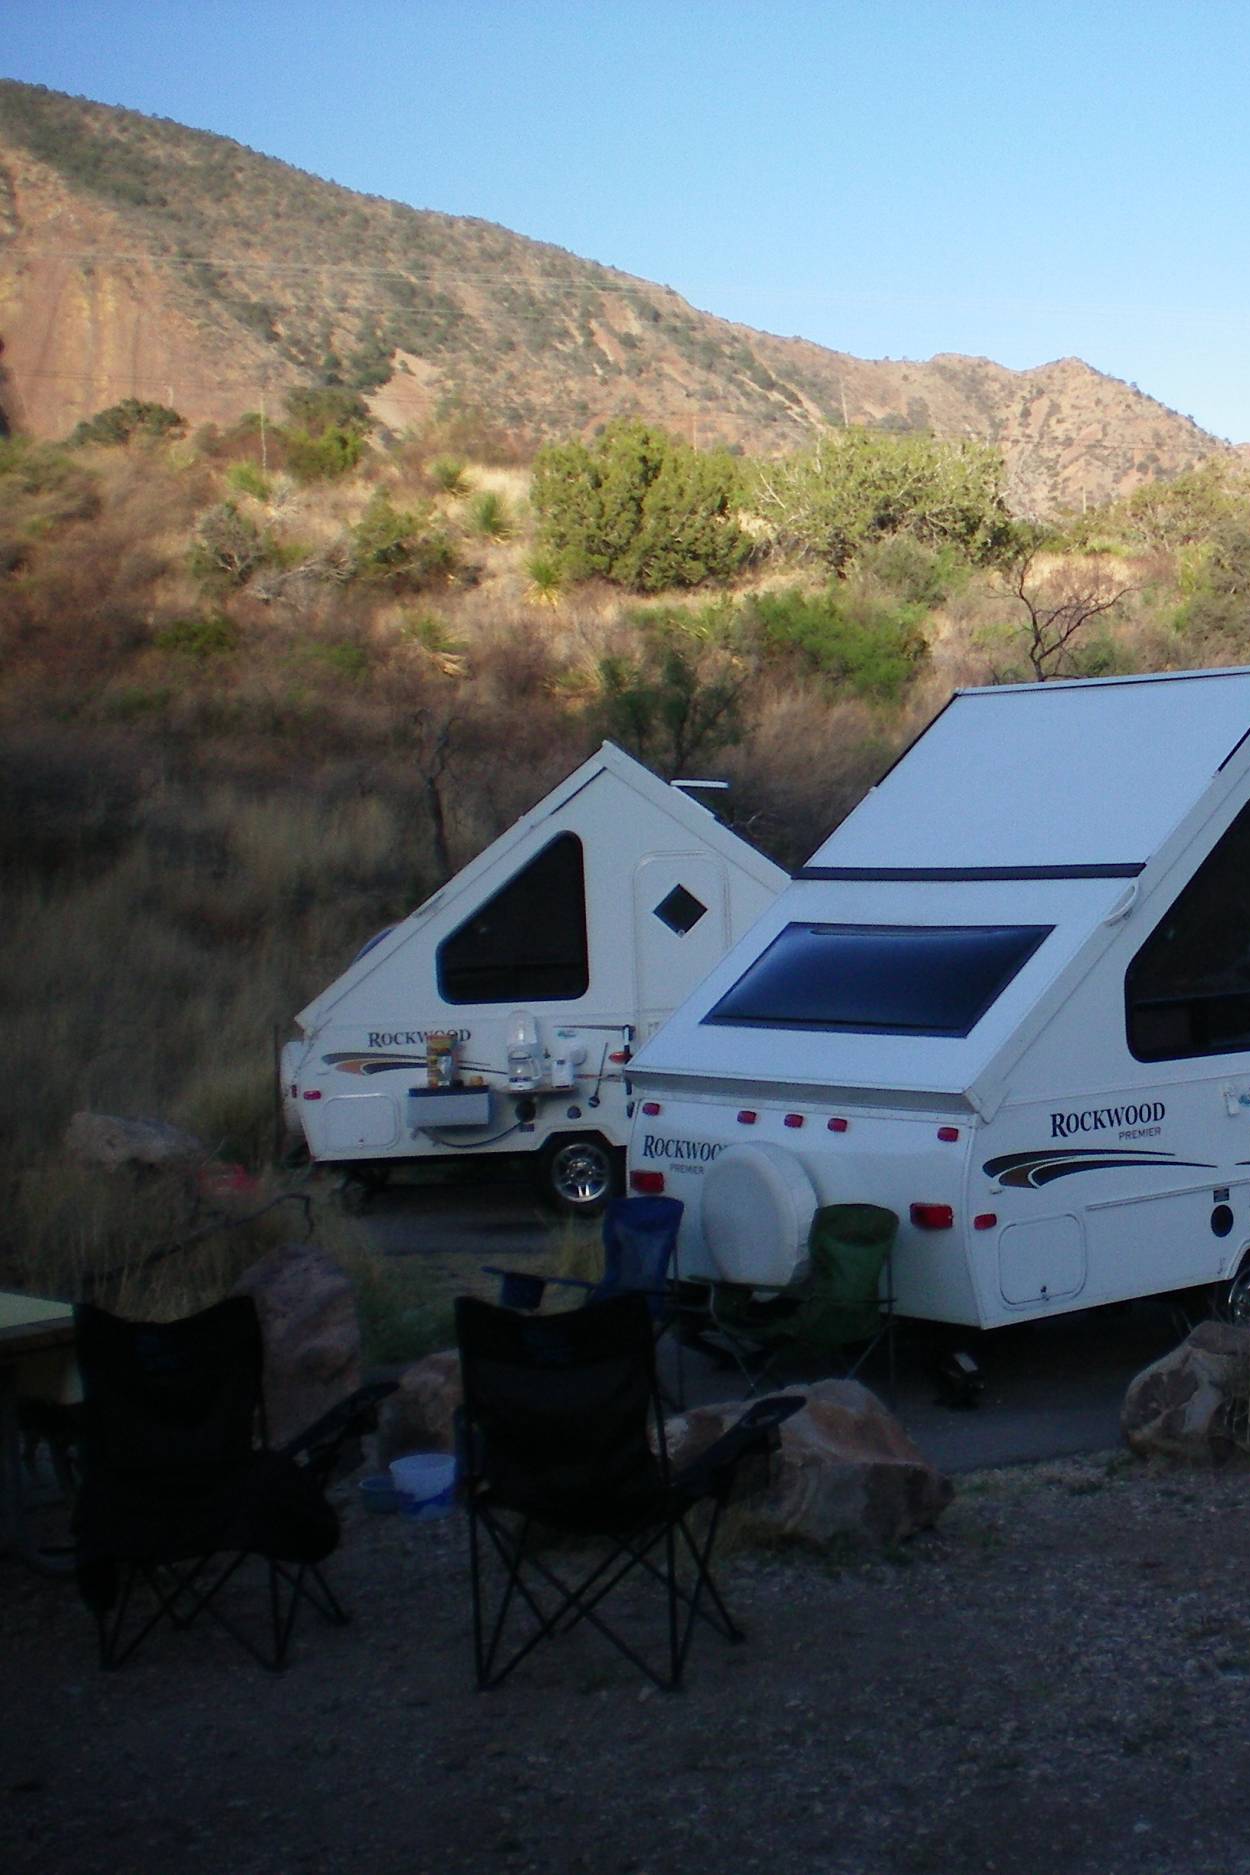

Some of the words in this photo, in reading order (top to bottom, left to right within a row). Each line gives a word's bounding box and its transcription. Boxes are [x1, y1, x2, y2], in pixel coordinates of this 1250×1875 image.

[1050, 1102, 1165, 1138] ROCKWOOD
[1118, 1127, 1161, 1140] PREMIER
[643, 1135, 721, 1161] ROCKWOO
